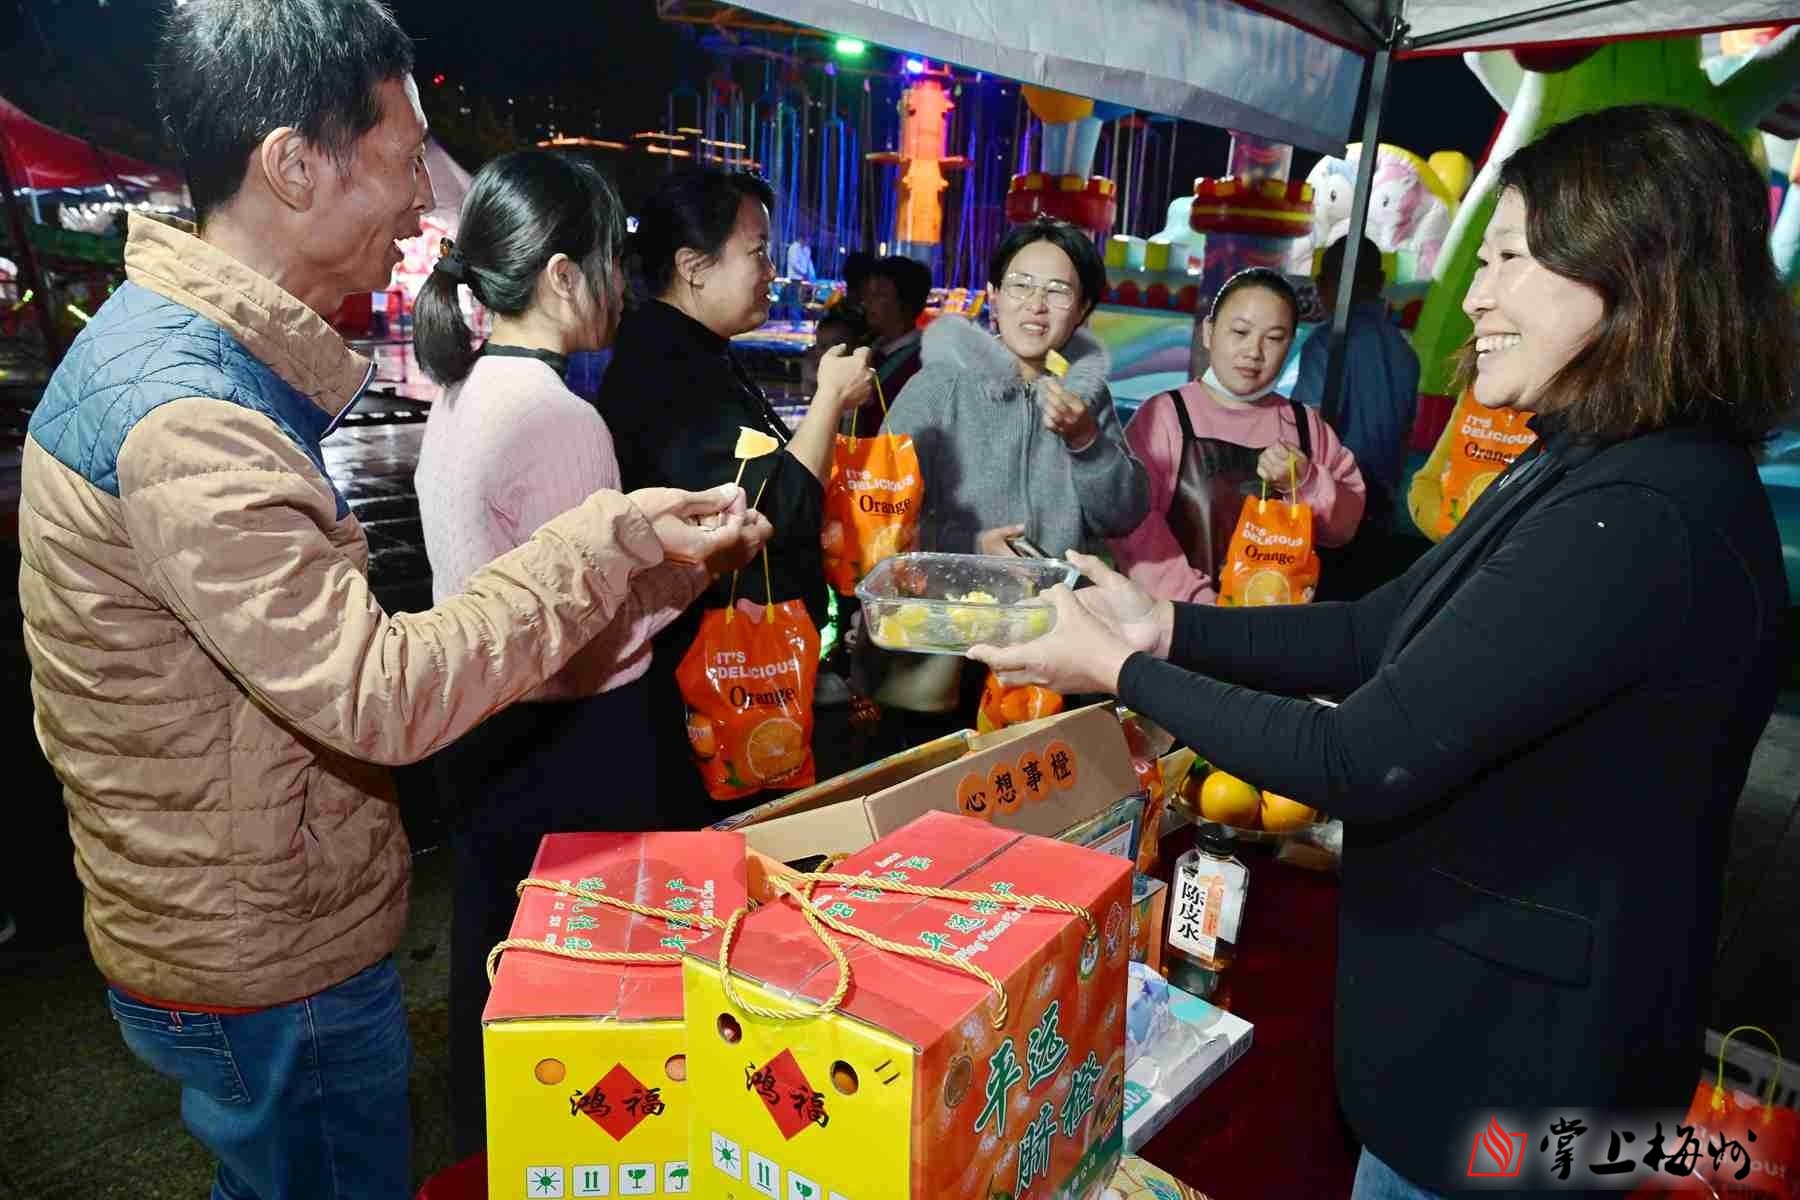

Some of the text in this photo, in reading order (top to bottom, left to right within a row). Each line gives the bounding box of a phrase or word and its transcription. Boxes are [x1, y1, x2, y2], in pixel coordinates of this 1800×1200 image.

[859, 494, 913, 515] Orange
[1244, 543, 1296, 565] Orange
[716, 651, 746, 665] IT'S
[717, 658, 801, 680] DELICIOUS
[729, 675, 796, 708] Orange
[965, 750, 1073, 813] 心想事橙
[1178, 881, 1206, 942] 陈皮水
[569, 1087, 666, 1117] 鸿福
[744, 1061, 829, 1128] 鸿福
